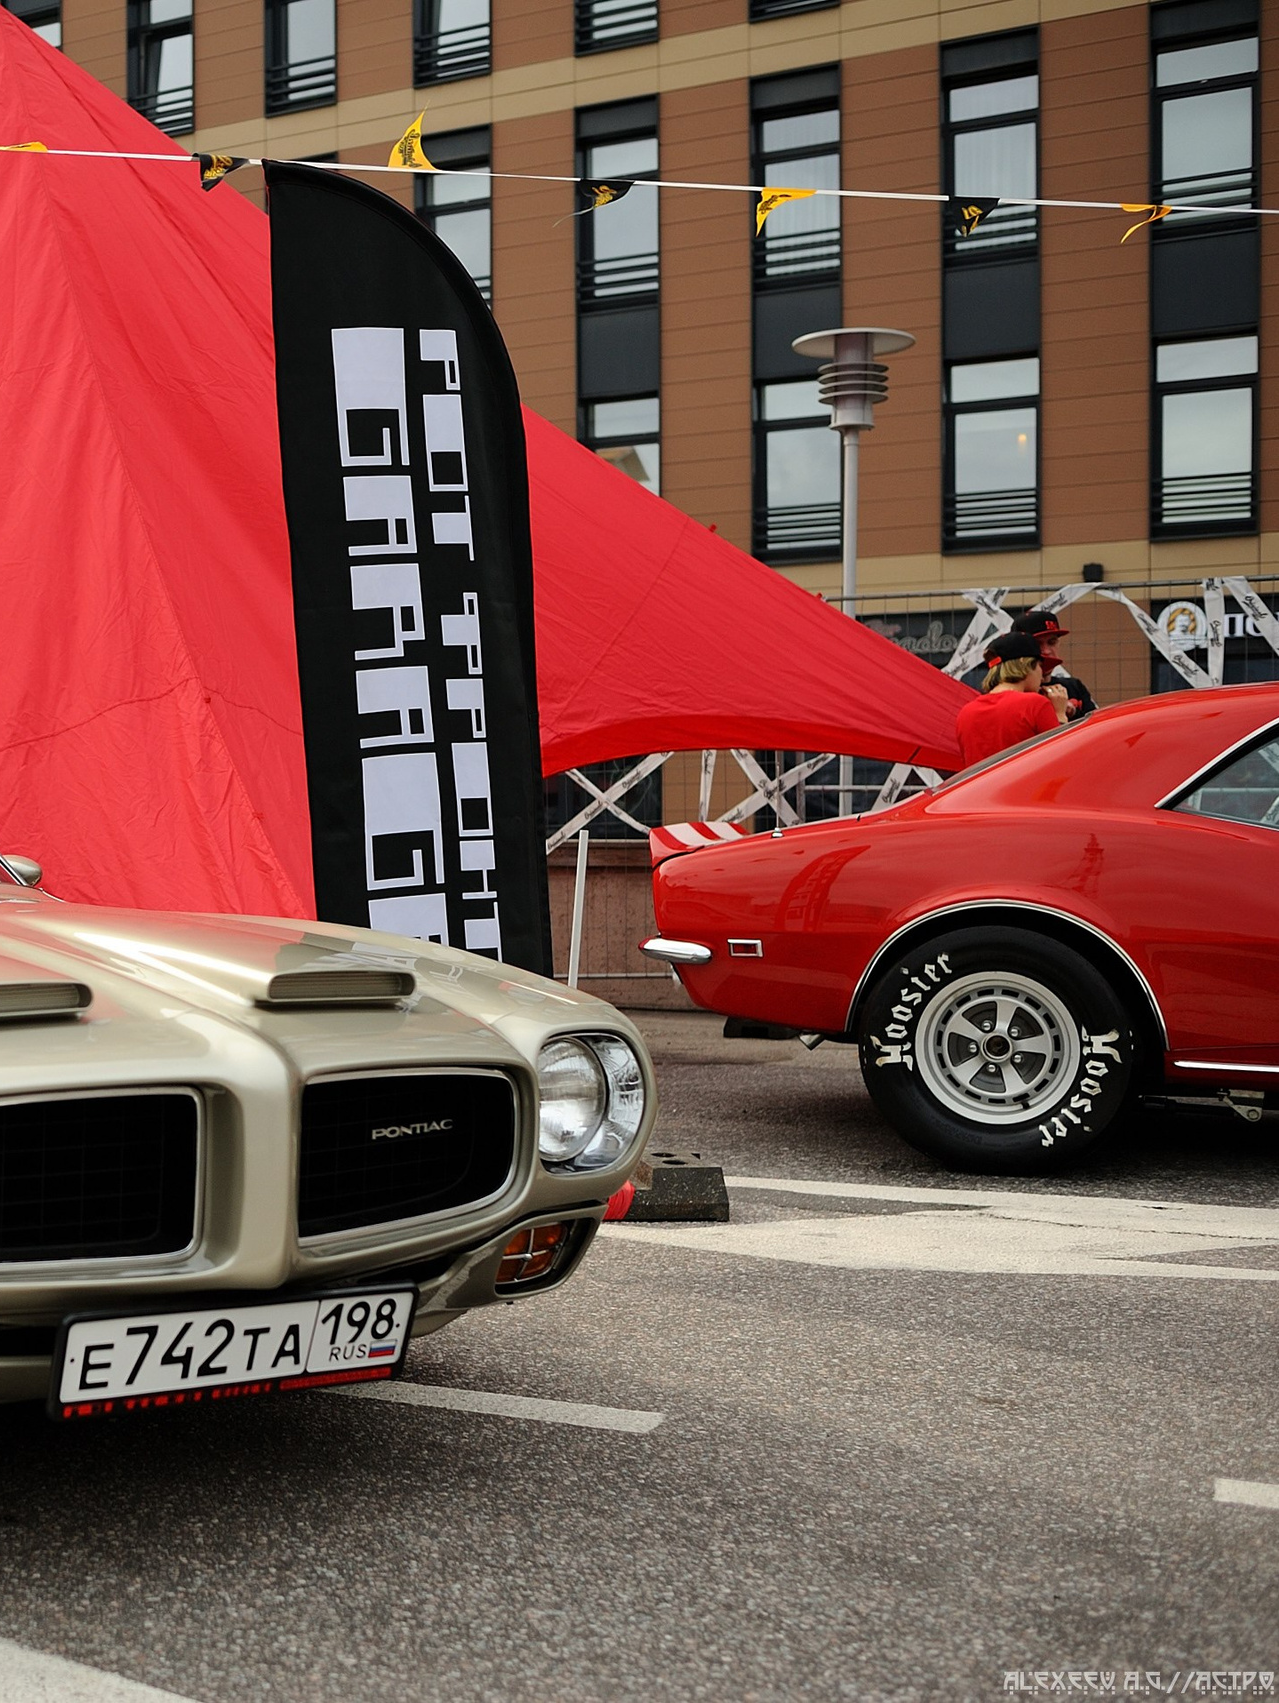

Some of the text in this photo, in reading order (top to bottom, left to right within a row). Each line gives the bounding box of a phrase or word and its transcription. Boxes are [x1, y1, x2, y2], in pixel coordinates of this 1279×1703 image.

[869, 952, 954, 1072] Hoosier
[1039, 1025, 1122, 1148] Hoosier
[372, 1118, 453, 1140] PONTIAC
[321, 1298, 396, 1345] 198
[329, 1343, 367, 1362] RUS
